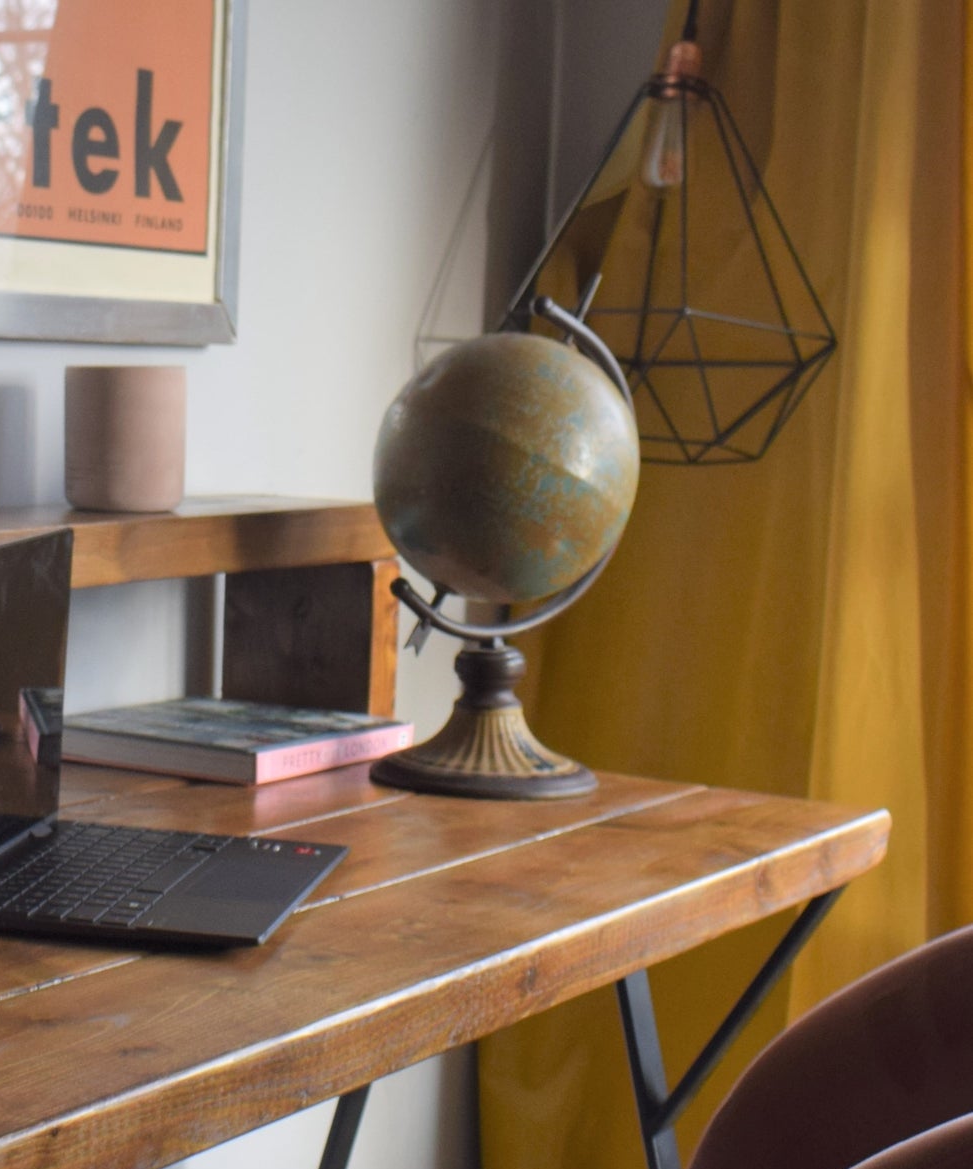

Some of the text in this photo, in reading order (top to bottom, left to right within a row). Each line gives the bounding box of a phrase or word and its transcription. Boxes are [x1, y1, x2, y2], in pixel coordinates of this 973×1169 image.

[68, 206, 122, 226] HELSINKI
[135, 213, 184, 232] FINLAND
[283, 749, 322, 768] PRETTY
